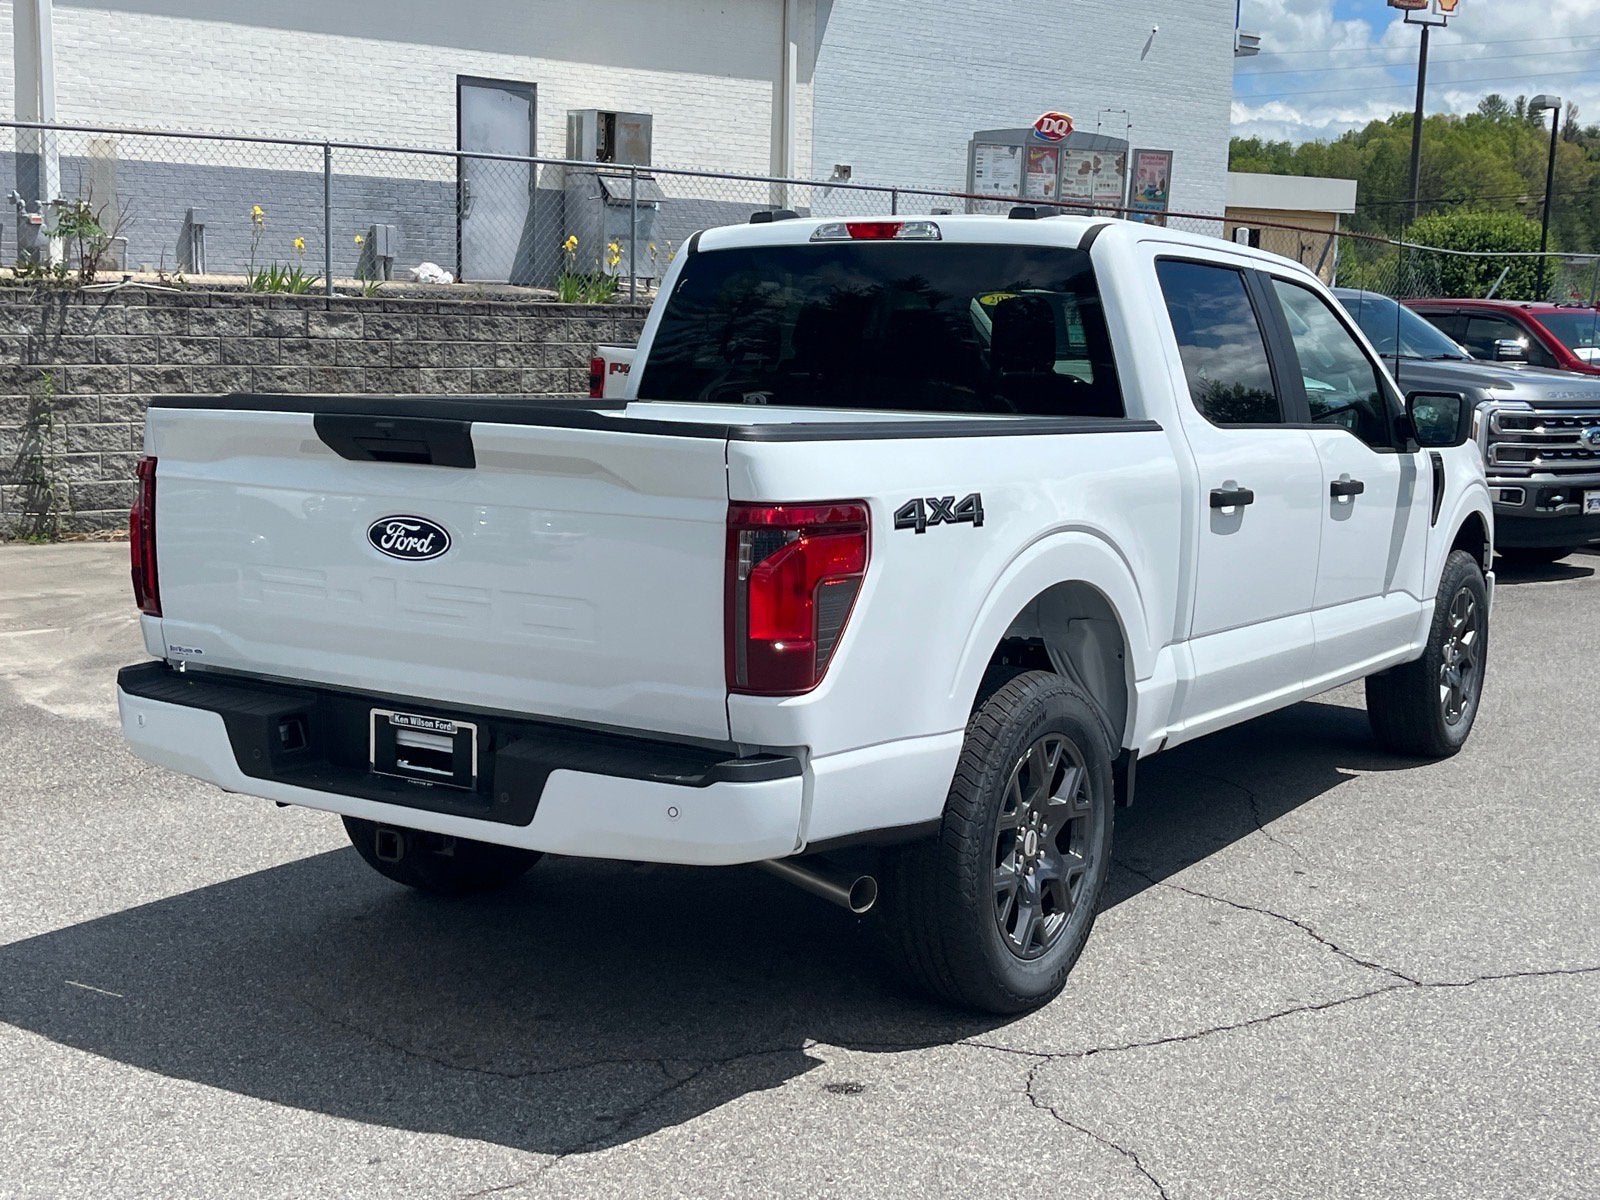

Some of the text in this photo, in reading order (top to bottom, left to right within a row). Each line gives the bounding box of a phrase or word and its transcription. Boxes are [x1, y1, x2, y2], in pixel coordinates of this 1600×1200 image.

[1040, 117, 1068, 136] DQ
[380, 521, 436, 553] Ford
[394, 714, 452, 731] Ken Wilson Ford
